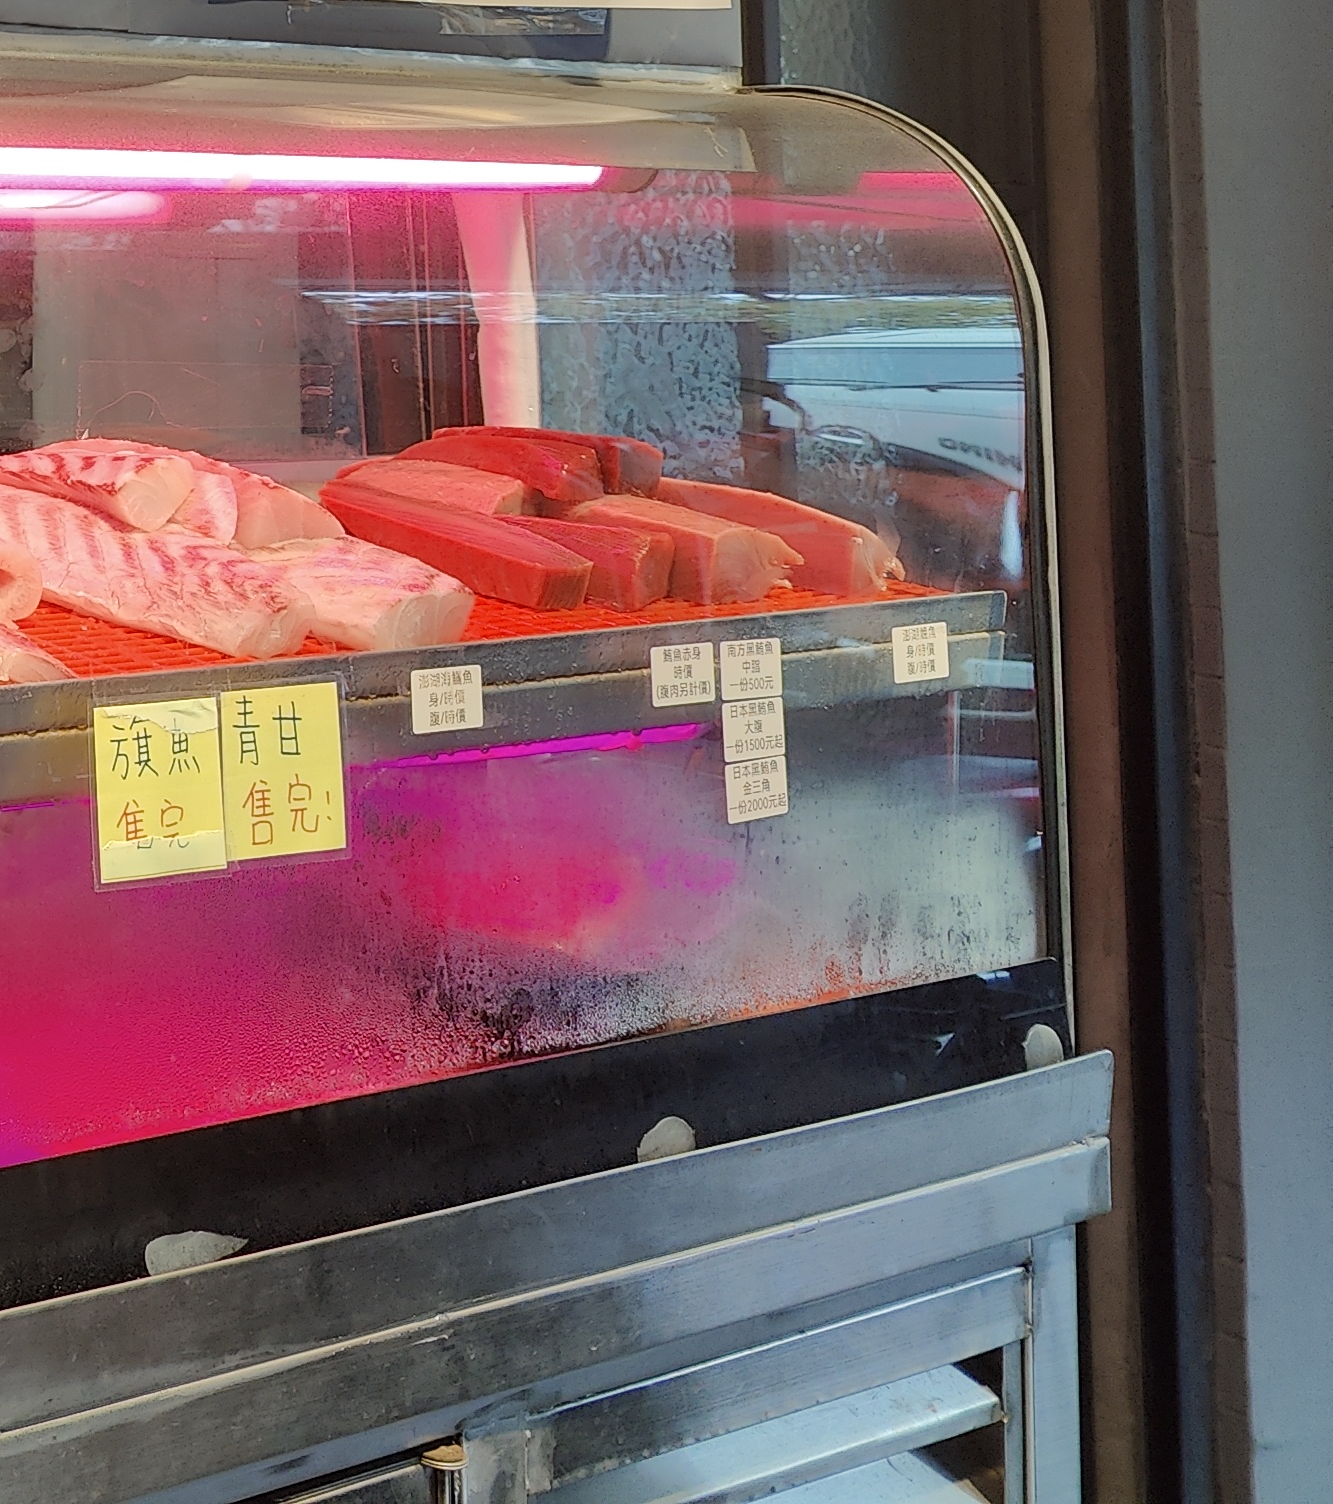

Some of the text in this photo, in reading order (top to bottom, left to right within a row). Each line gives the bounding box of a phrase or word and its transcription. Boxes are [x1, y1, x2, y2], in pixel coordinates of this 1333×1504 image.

[730, 677, 773, 691] 一份500元
[730, 701, 776, 718] 日本黑鮪魚
[233, 695, 302, 766] 青甘
[110, 716, 201, 780] 旗魚
[726, 734, 783, 754] 一份1500元起
[733, 760, 779, 779] 日本黑鮪魚
[743, 779, 770, 795] 金三角
[729, 793, 786, 814] 一份2000元起
